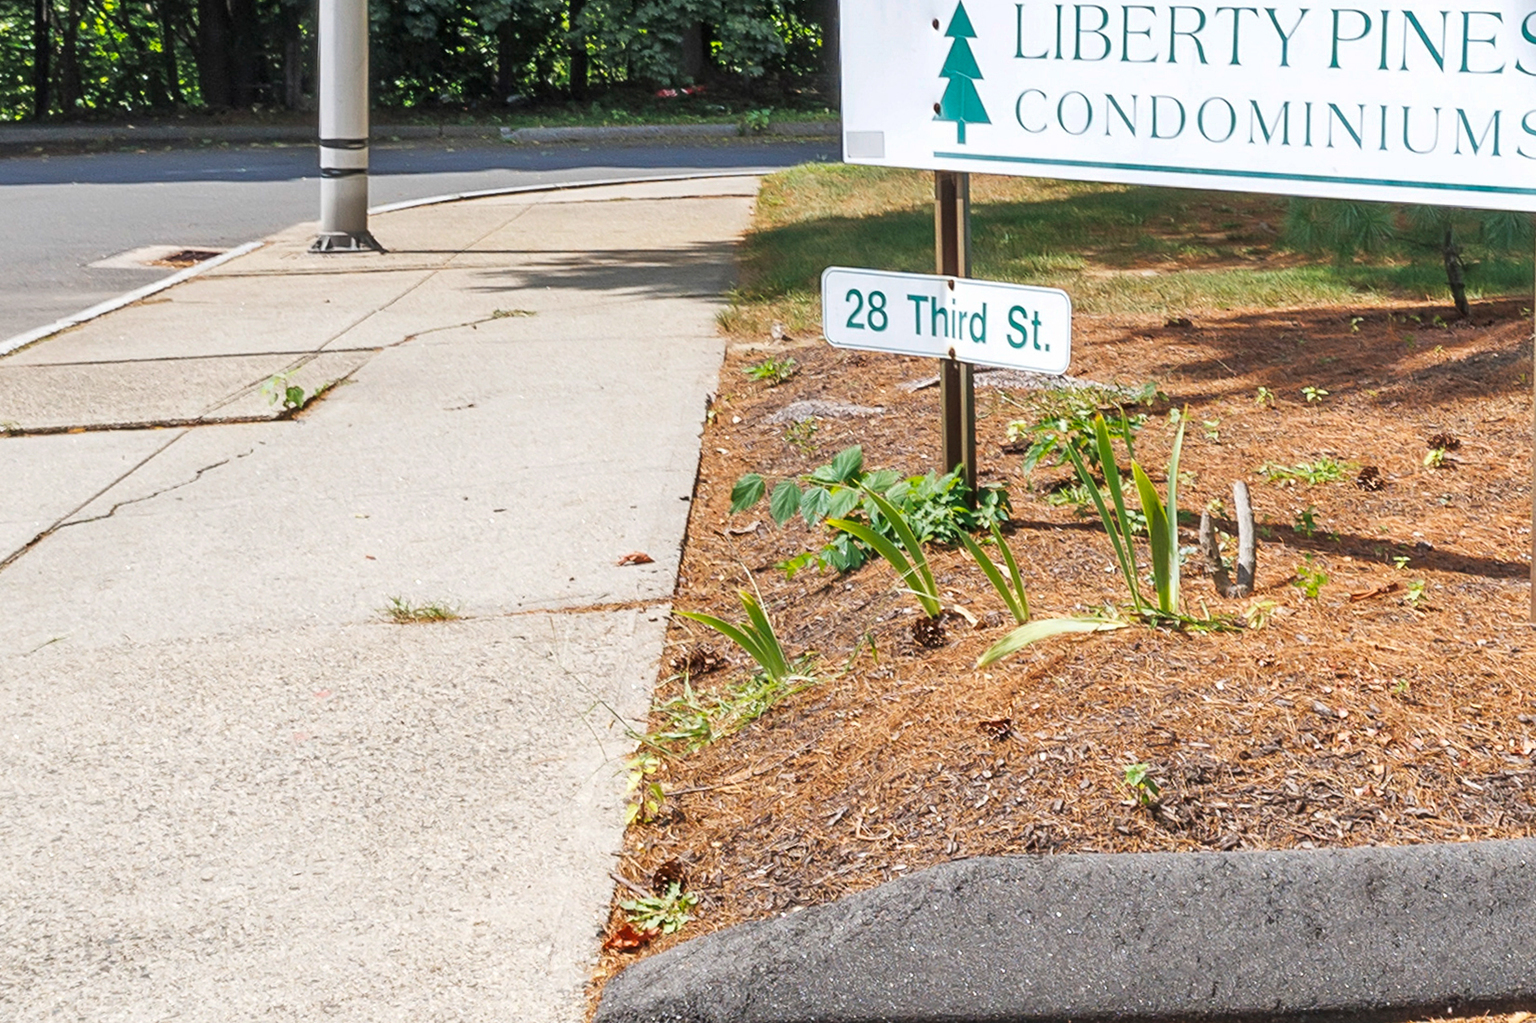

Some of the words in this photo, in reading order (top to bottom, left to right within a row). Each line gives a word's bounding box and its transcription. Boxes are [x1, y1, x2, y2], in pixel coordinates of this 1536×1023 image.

[1013, 2, 1312, 68] LIBERTY
[845, 288, 889, 332] 28
[907, 294, 987, 344] Third
[1006, 305, 1050, 352] St.
